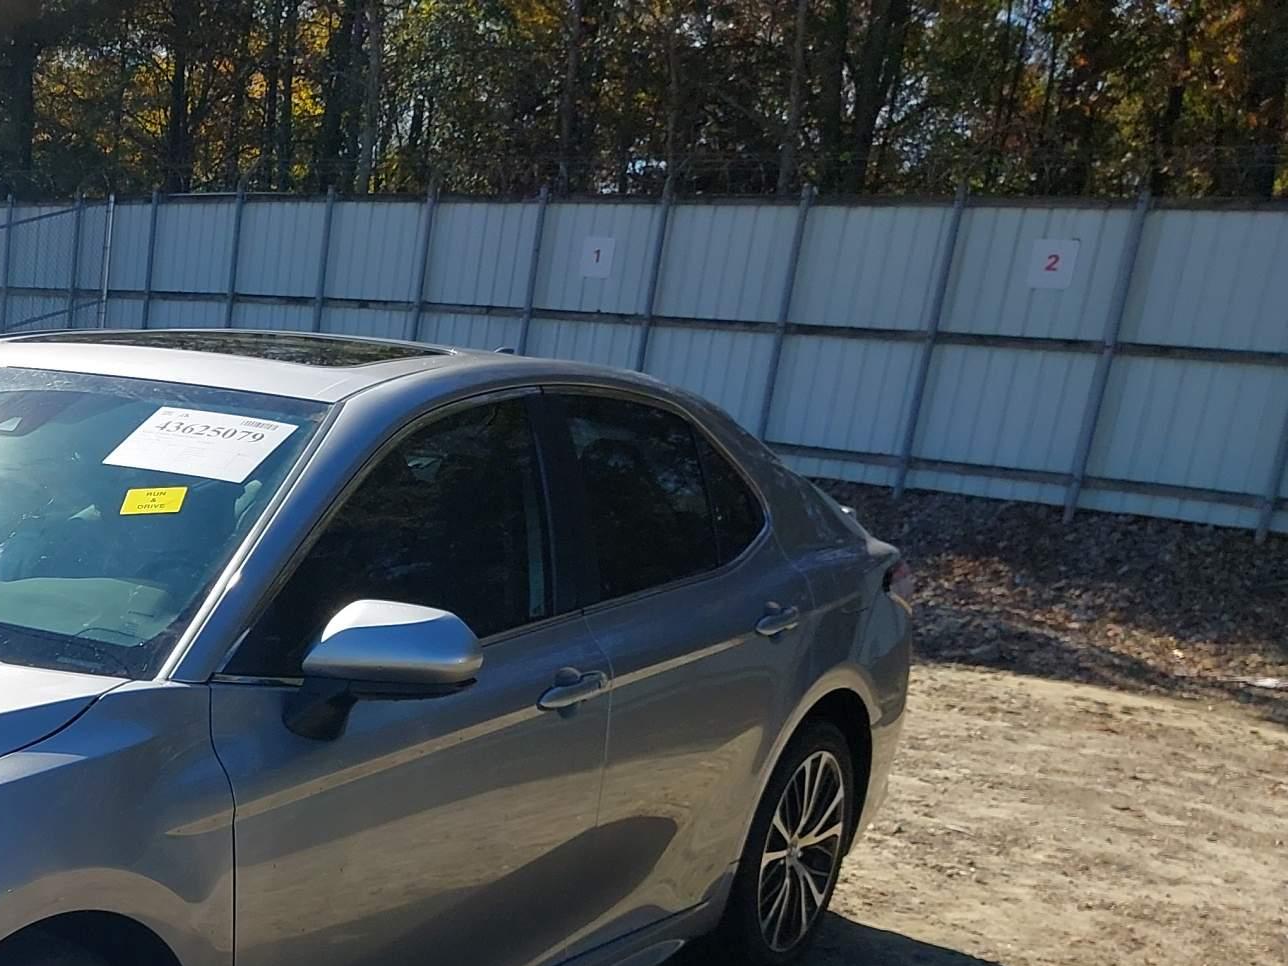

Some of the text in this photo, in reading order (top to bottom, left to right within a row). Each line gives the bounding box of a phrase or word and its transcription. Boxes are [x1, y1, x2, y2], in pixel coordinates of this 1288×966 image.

[593, 249, 601, 263] 1
[1044, 254, 1060, 271] 2
[155, 420, 266, 443] 43625079
